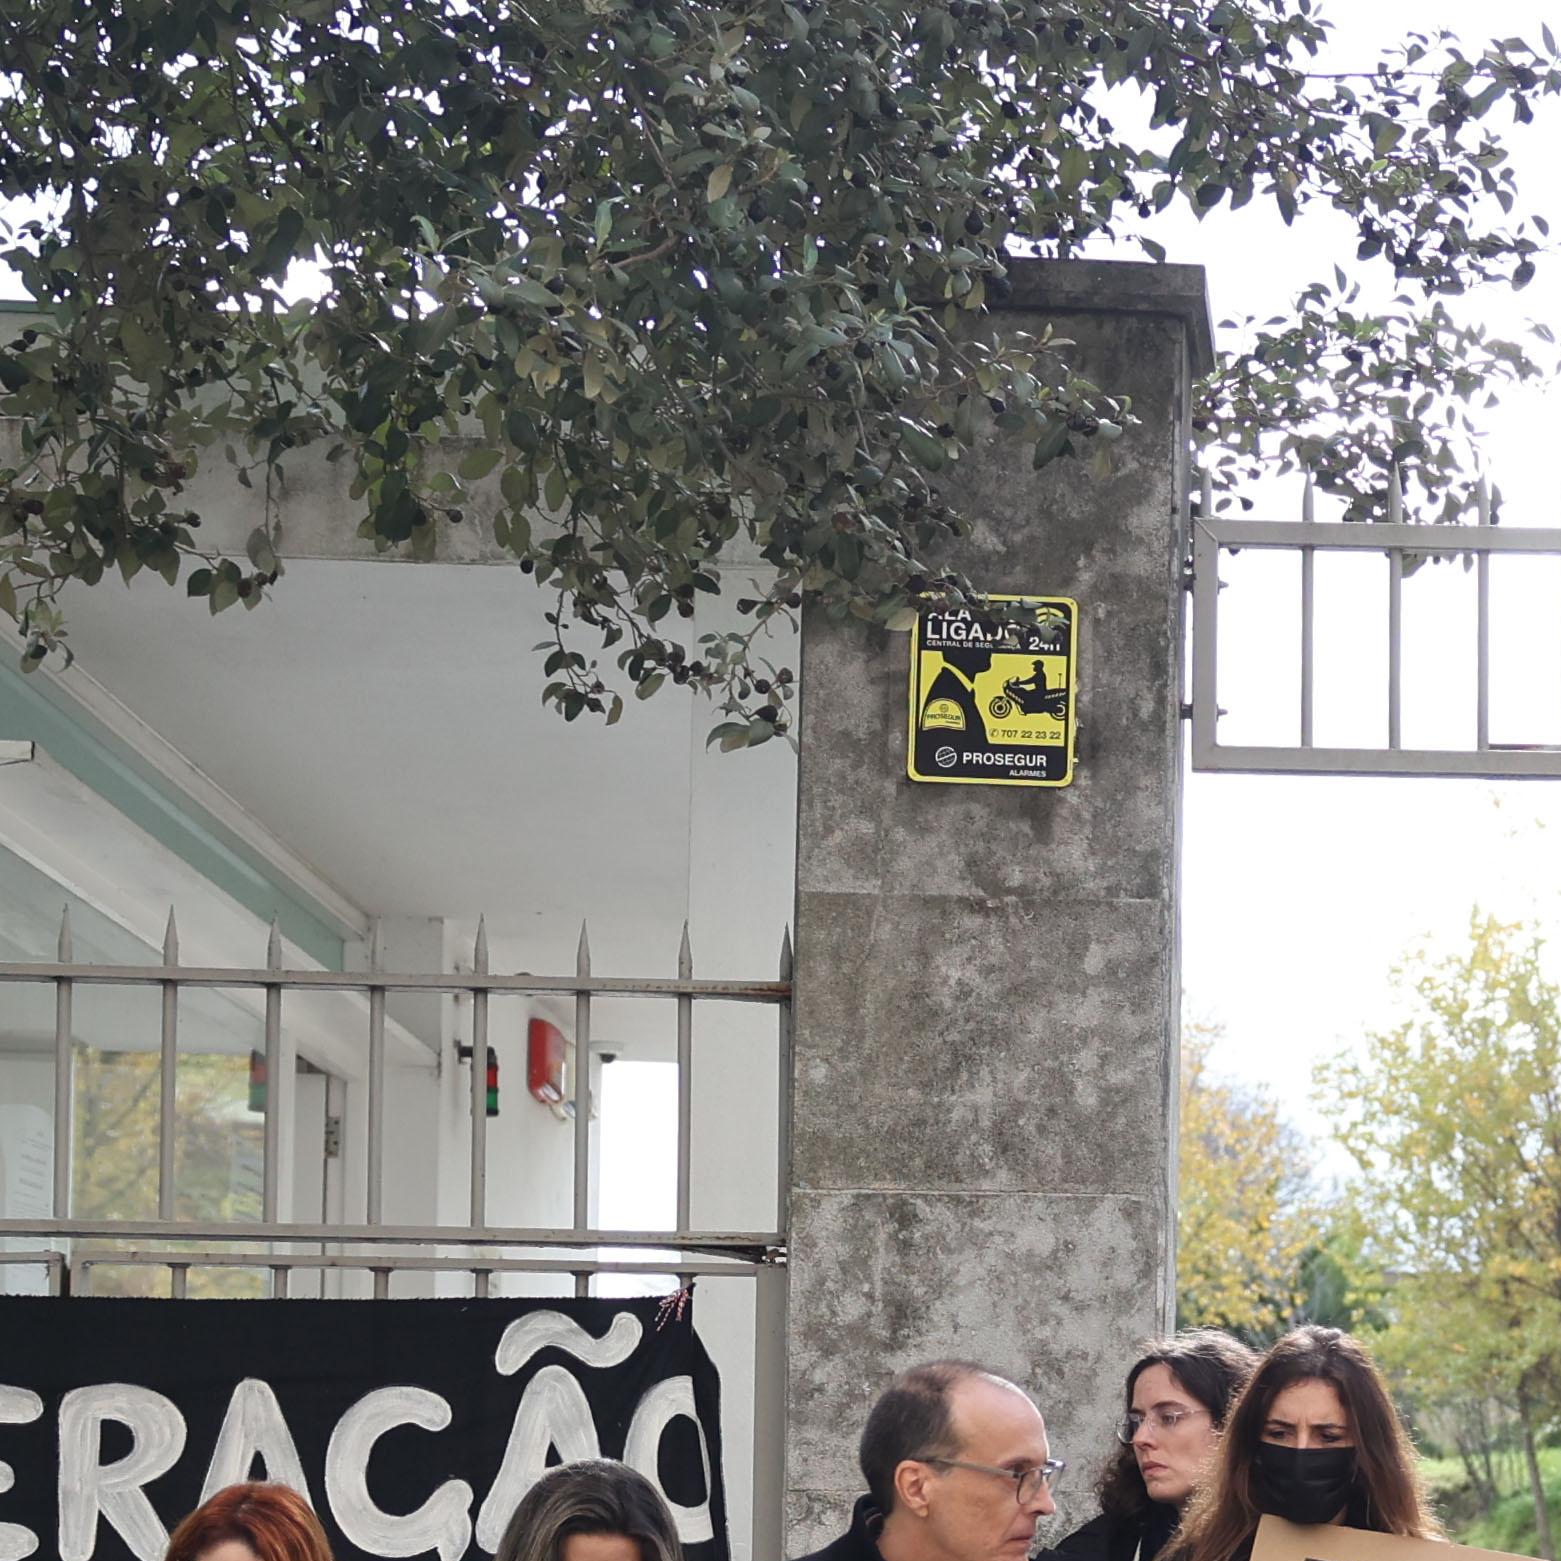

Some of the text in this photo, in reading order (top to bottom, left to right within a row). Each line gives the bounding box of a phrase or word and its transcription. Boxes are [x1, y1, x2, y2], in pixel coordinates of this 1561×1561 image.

[926, 640, 960, 648] CENTRAL
[1001, 729, 1061, 740] 707 22 23 22
[962, 752, 1047, 767] PROSEGUR
[1009, 769, 1047, 778] ALARMES
